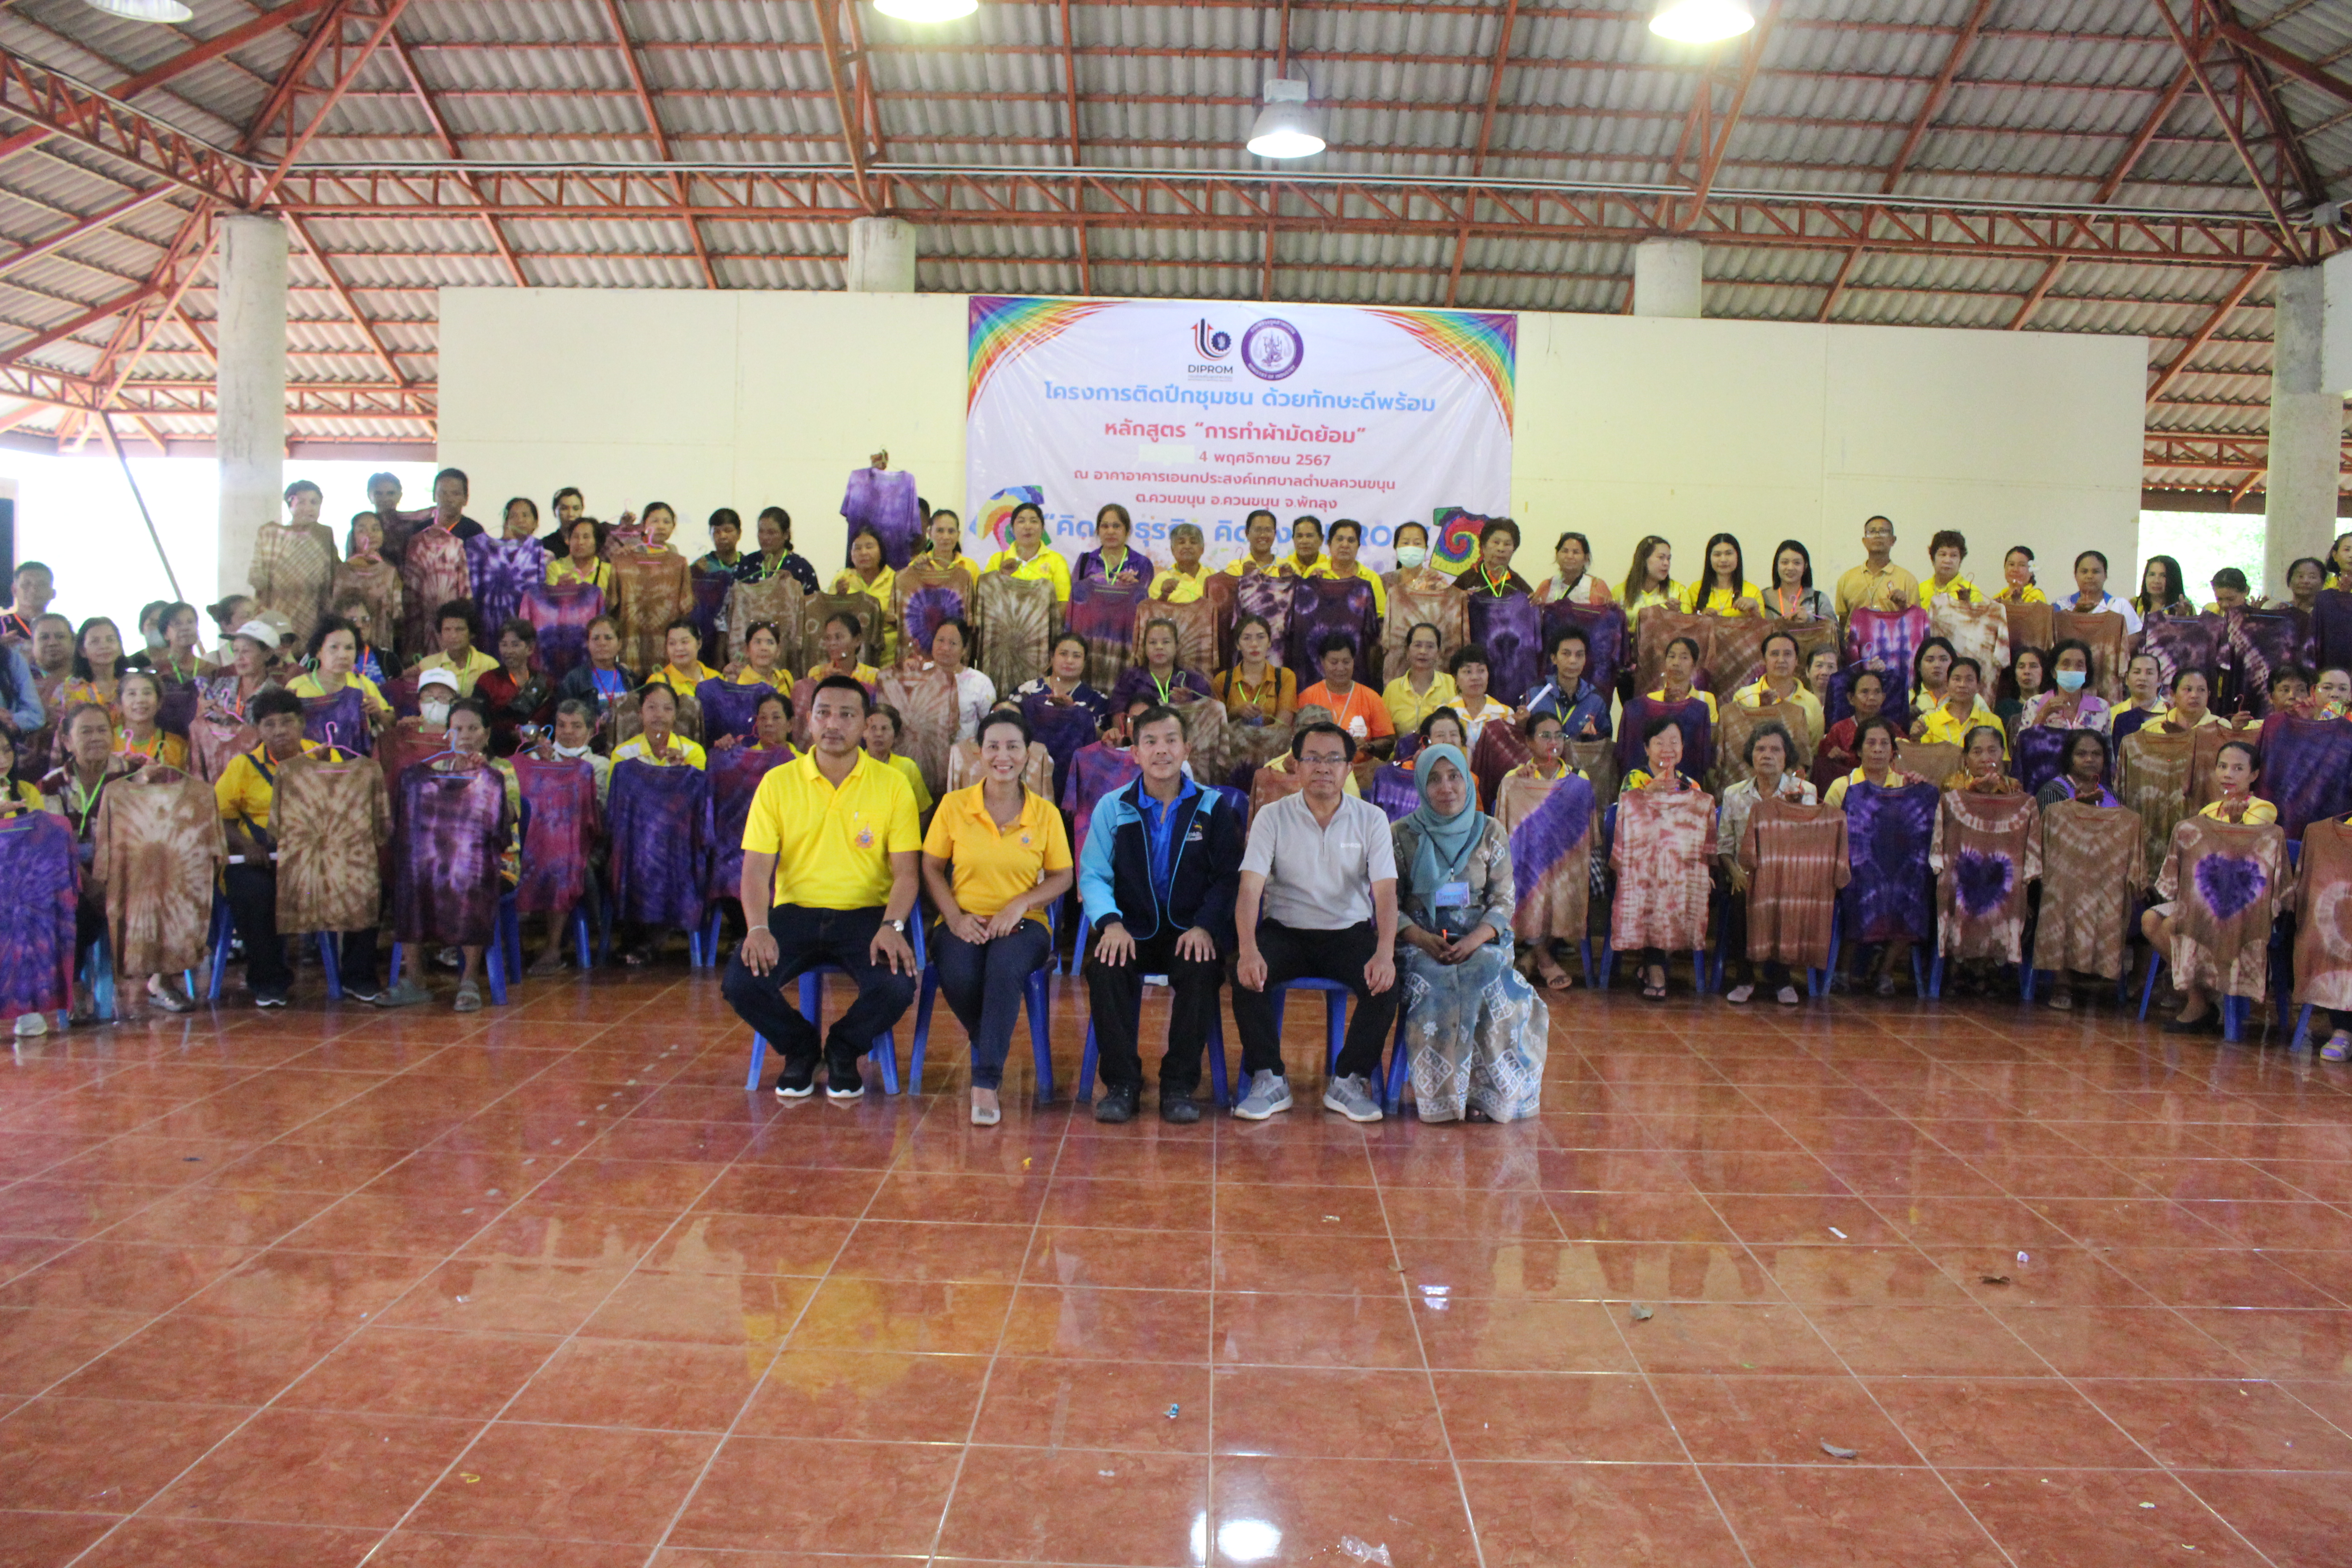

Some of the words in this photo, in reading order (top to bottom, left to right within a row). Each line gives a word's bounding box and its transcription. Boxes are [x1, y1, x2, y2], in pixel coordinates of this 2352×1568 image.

[1187, 364, 1233, 374] DIPROM
[1044, 381, 1254, 410] โครงการติดปีกชุมชน
[1262, 387, 1436, 412] ด้วยทักษะดีพร้อม
[1105, 418, 1186, 442] หลักสูตร
[1199, 451, 1208, 462] 4
[1214, 452, 1290, 466] พฤศจิกายน
[1296, 454, 1331, 466] 2567
[1074, 470, 1089, 479] ณ
[1136, 493, 1205, 508] ต.ควนขนุน
[1211, 496, 1280, 511] อ.ควนขนุน
[1285, 495, 1338, 513] จ.พัทลุง
